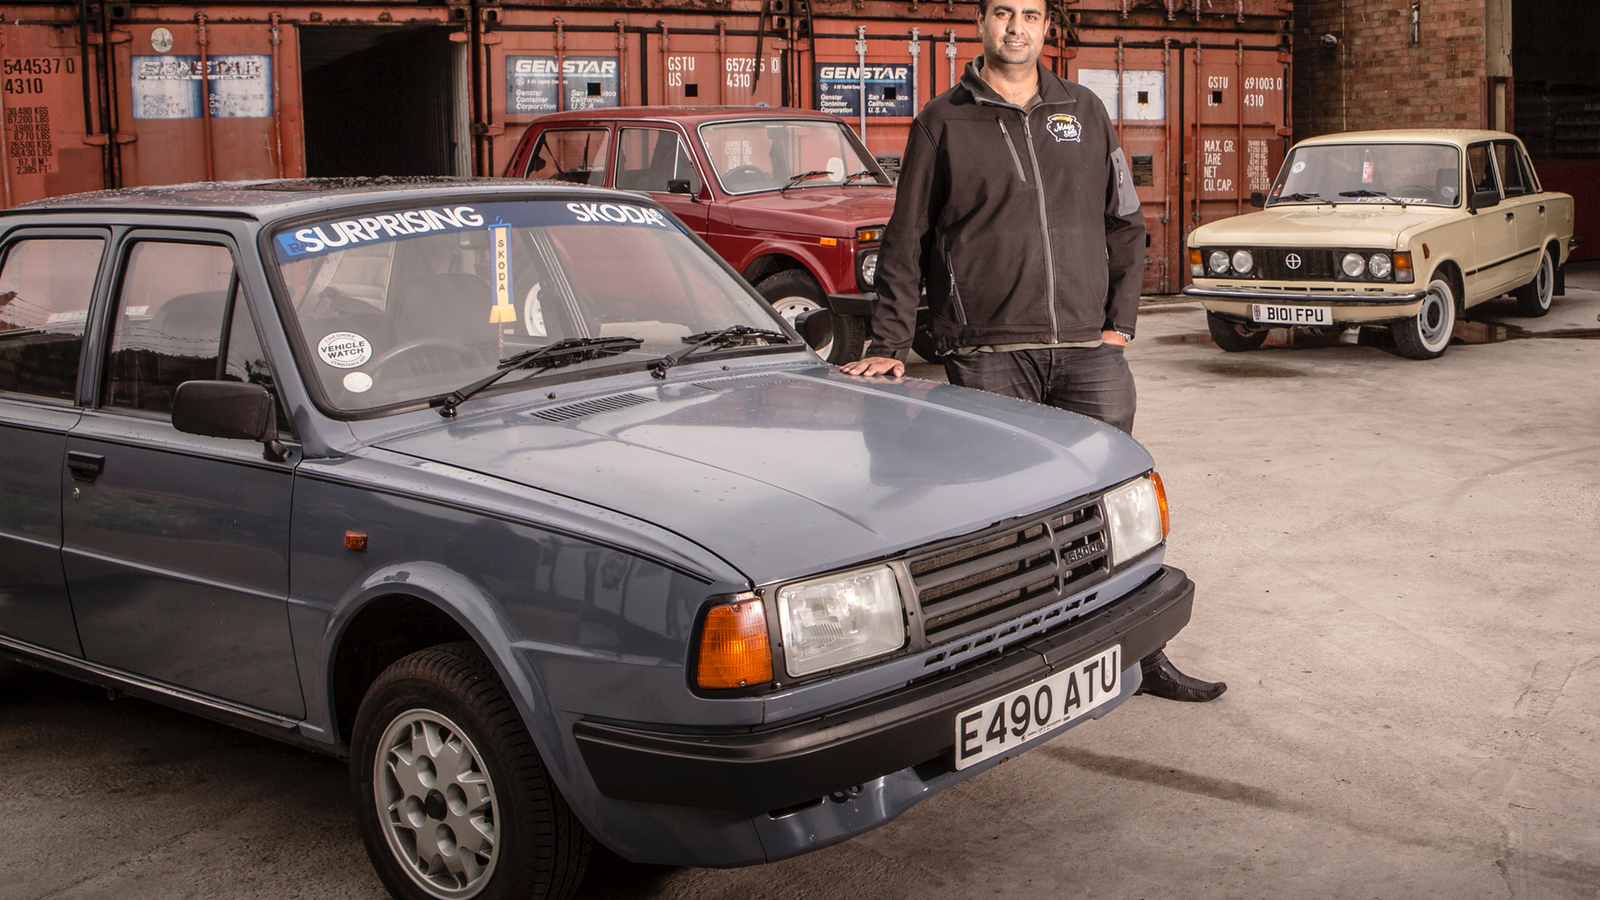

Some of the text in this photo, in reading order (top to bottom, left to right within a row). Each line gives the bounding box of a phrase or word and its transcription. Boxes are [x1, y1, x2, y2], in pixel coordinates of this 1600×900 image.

[4, 57, 75, 75] 544537 0
[515, 60, 617, 74] GENSTAR
[668, 56, 696, 71] GSTU
[773, 59, 780, 72] 0
[668, 72, 682, 87] US
[820, 66, 908, 80] GENSTAR
[5, 78, 43, 94] 4310
[726, 73, 751, 88] 4310
[1208, 76, 1229, 89] GSTU
[1244, 77, 1283, 90] 691003 0
[516, 103, 557, 111] Corporation
[1244, 94, 1264, 107] 4310
[35, 106, 49, 115] KGS
[35, 114, 49, 123] LBS
[36, 124, 50, 132] KGS
[36, 131, 51, 140] LBS
[37, 140, 52, 149] KGS
[1204, 140, 1236, 153] MAX. GR.
[38, 148, 52, 157] LBS
[1204, 153, 1222, 165] TARE
[1203, 166, 1217, 178] NET
[1203, 179, 1216, 191] CU.
[295, 206, 484, 252] SURPRISING
[498, 239, 506, 292] SKODA
[1296, 308, 1324, 322] FPU
[321, 340, 366, 353] VEHICLE
[327, 347, 365, 359] WATCH
[960, 650, 1118, 761] E490 ATU
